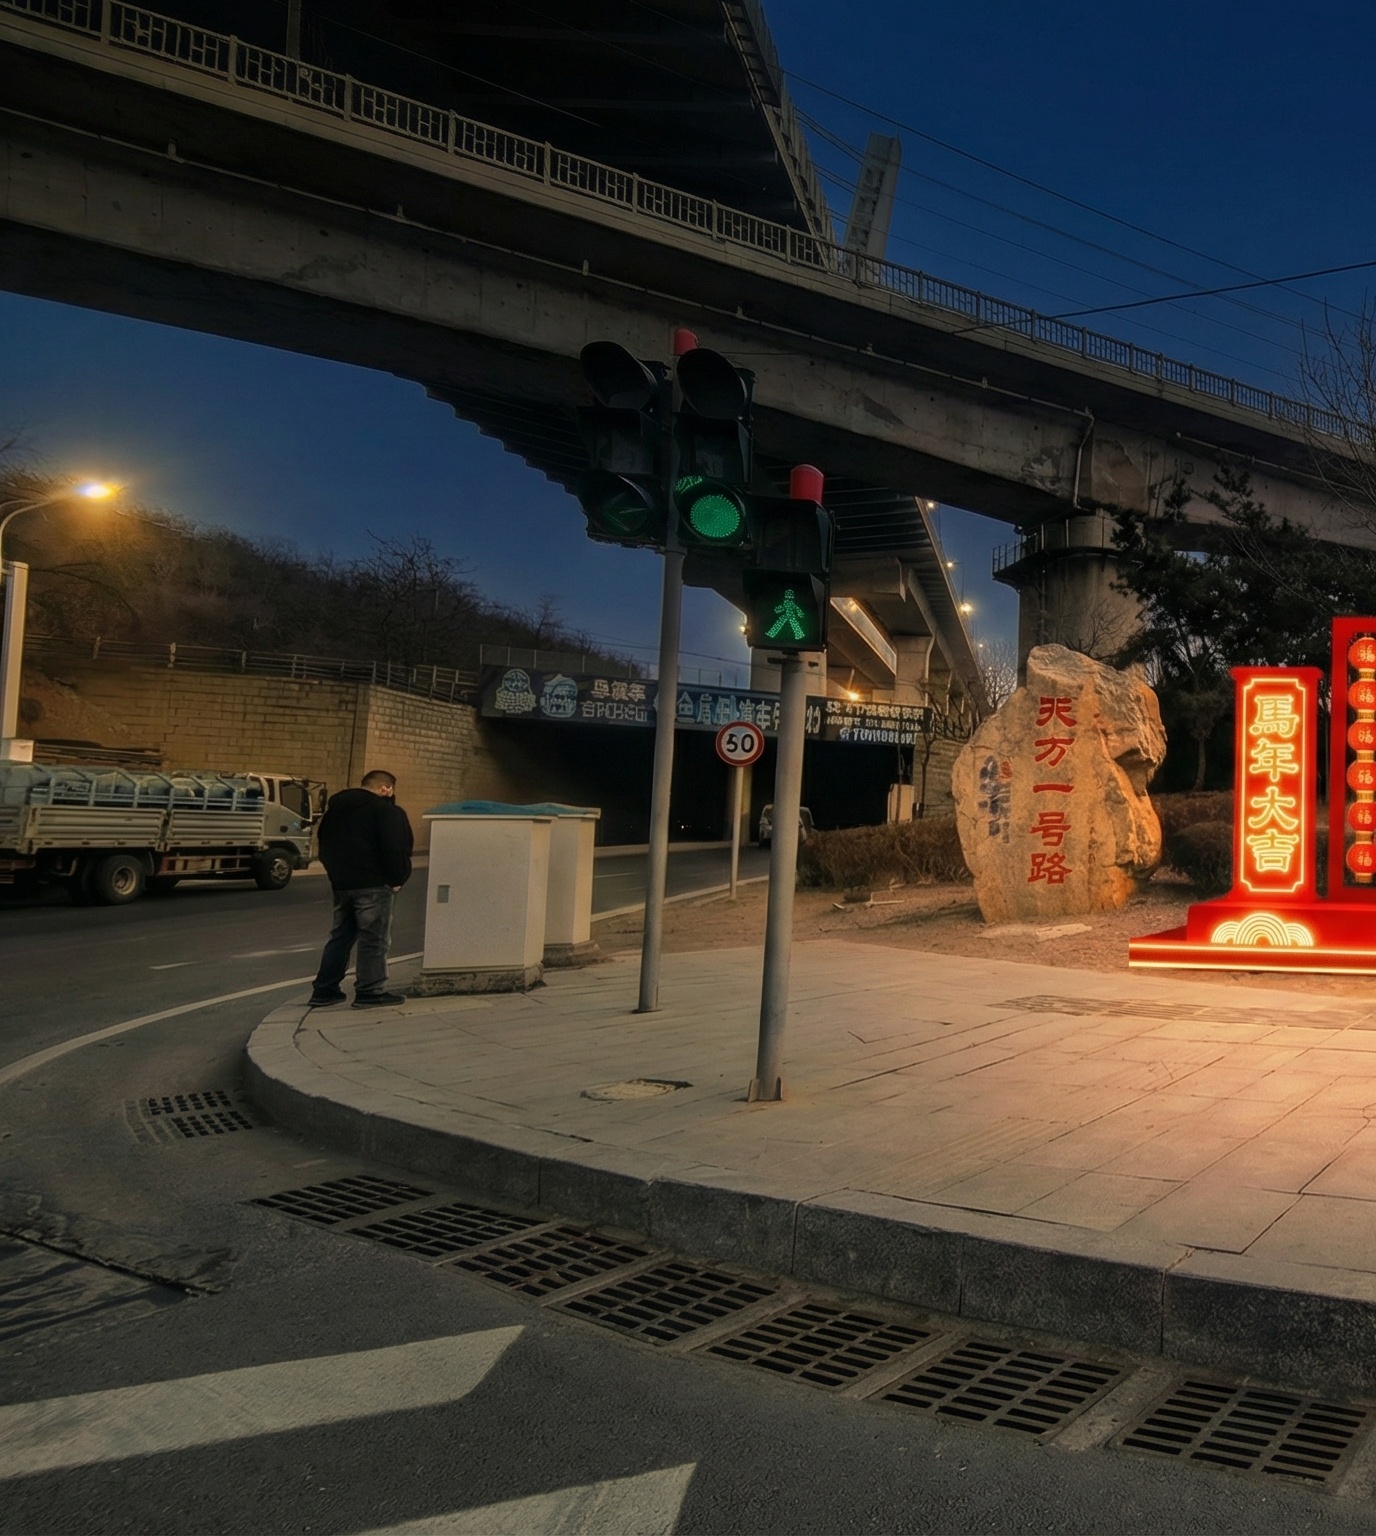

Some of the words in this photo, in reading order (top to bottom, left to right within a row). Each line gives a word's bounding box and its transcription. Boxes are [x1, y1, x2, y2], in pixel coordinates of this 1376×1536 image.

[726, 733, 755, 753] 50
[1247, 693, 1300, 874] 馬年大吉
